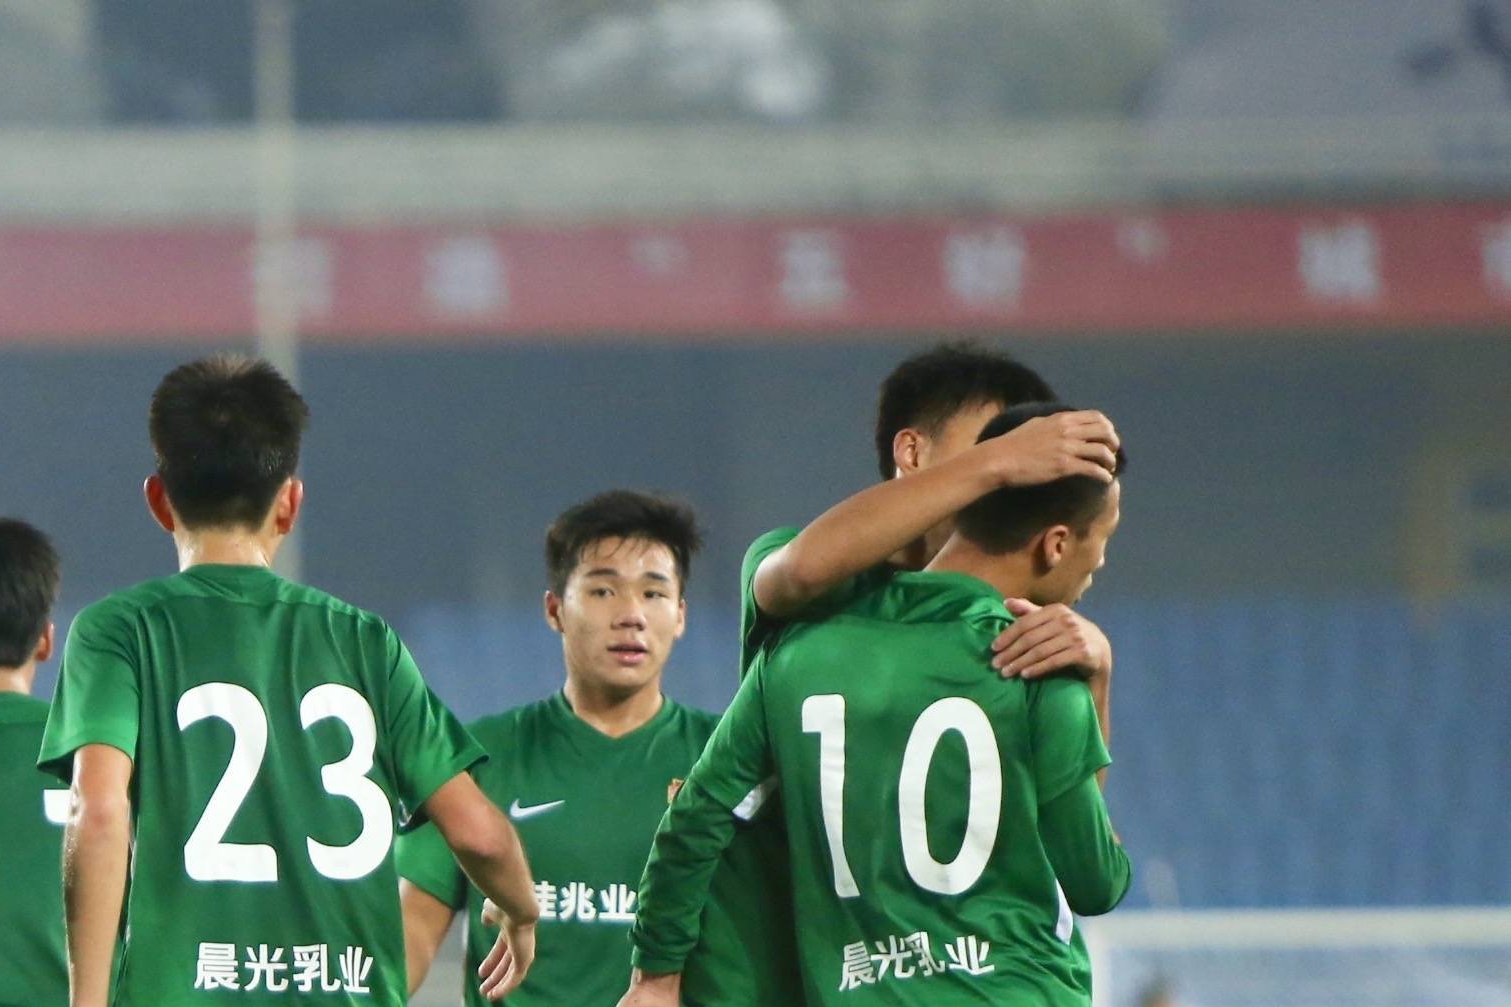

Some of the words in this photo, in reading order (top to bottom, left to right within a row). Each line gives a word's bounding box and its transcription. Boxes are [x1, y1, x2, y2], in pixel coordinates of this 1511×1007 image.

[176, 682, 392, 883] 23
[801, 693, 1002, 898] 10
[194, 942, 374, 994] 晨光乳业
[839, 931, 995, 992] 晨光乳业
